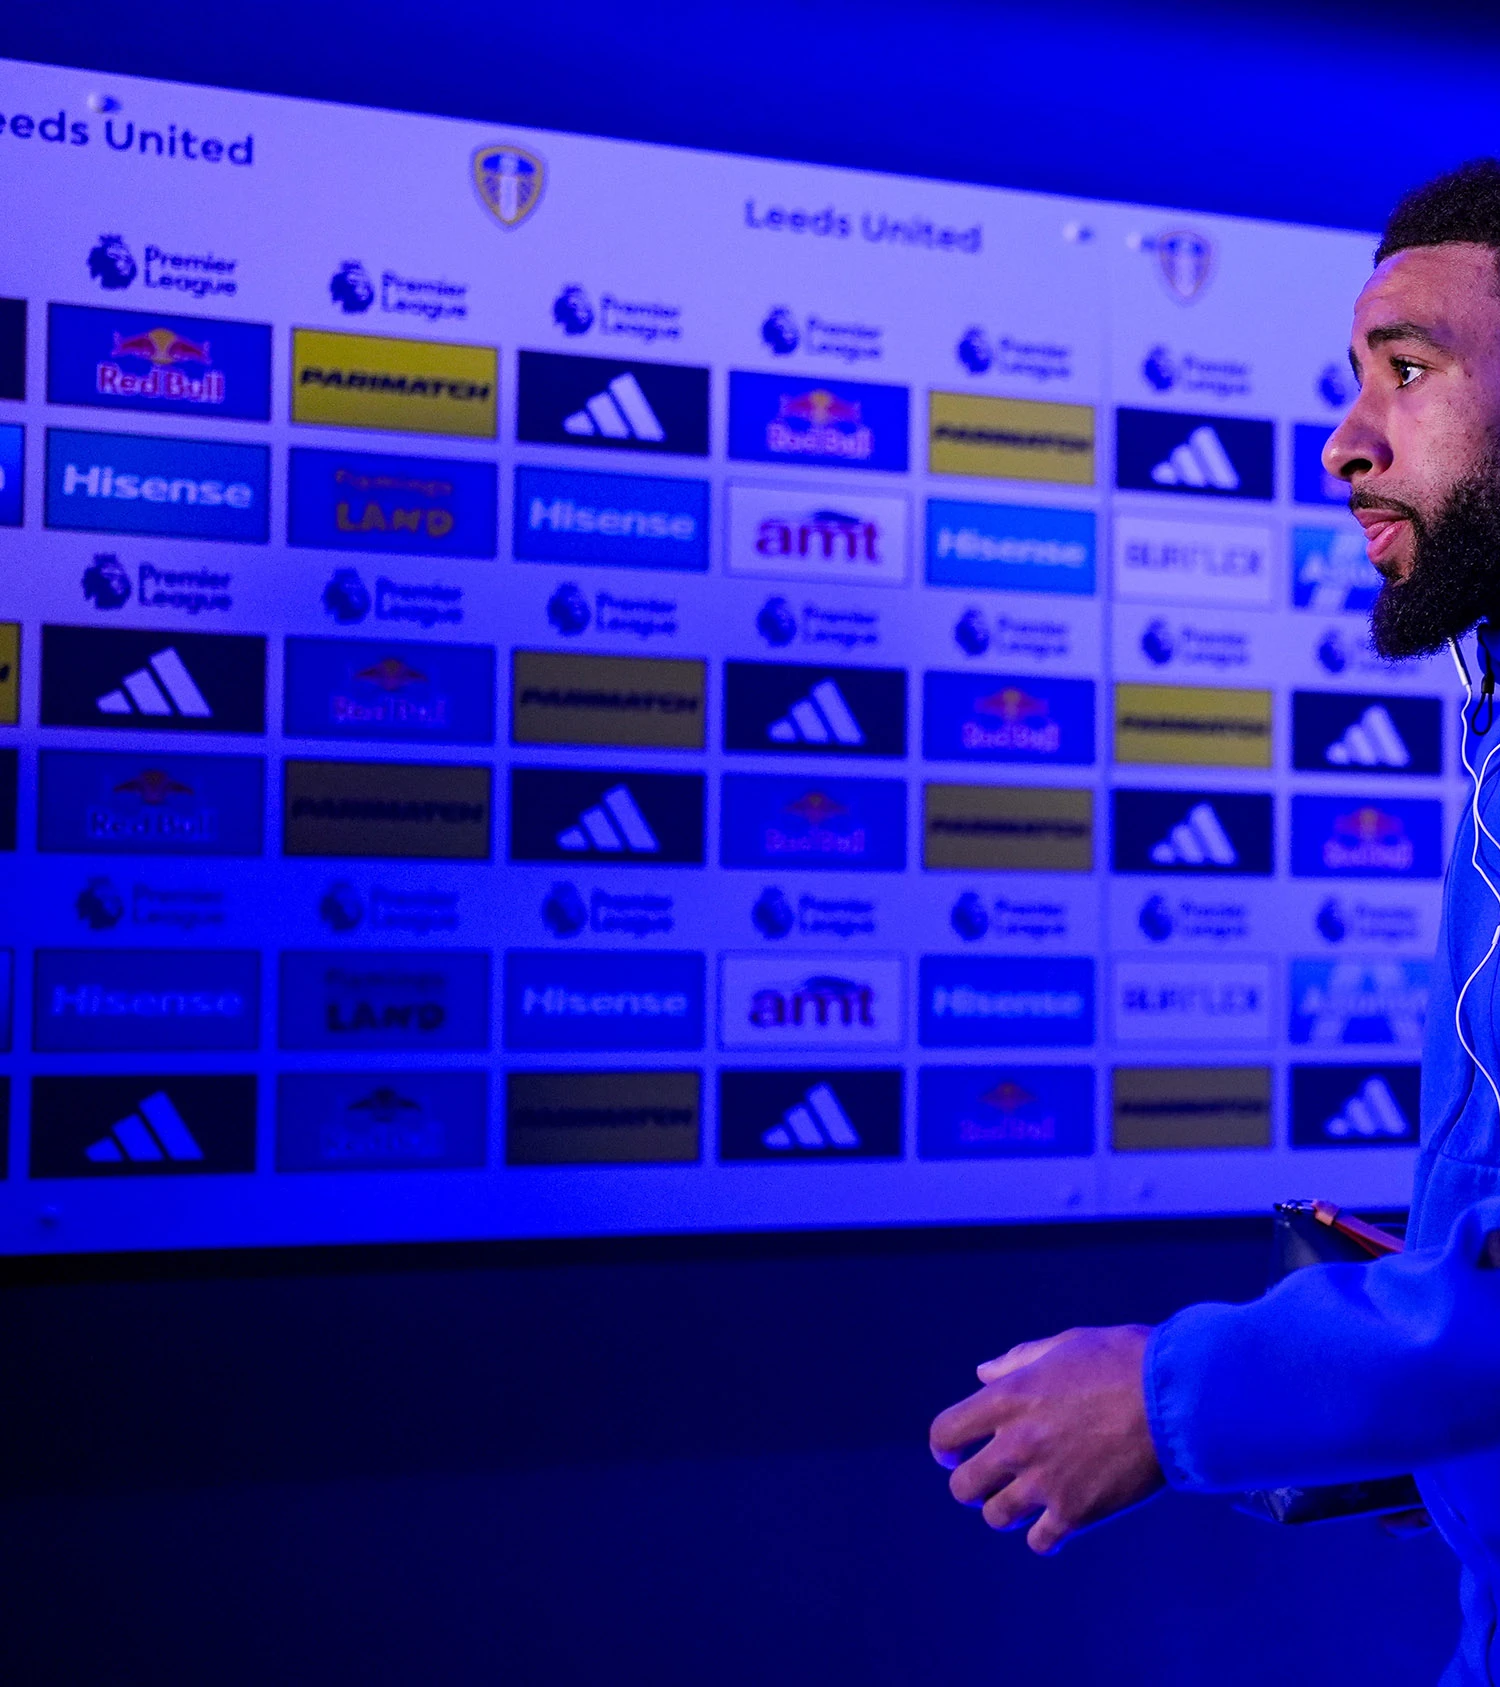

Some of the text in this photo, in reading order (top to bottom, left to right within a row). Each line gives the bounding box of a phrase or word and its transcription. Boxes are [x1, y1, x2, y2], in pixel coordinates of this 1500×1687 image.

[0, 110, 255, 167] eds United
[745, 197, 984, 255] Leeds United
[144, 243, 238, 275] Premier
[144, 267, 238, 299] League
[381, 269, 468, 298] Premier
[381, 293, 468, 321] League
[97, 361, 225, 403] Red Bull
[300, 366, 492, 402] PARIMATCH
[62, 463, 254, 509] Hisense
[336, 501, 455, 538] LAND
[529, 498, 697, 541] Hisense
[755, 515, 880, 563] amt
[937, 527, 1088, 568] Hisense
[51, 983, 244, 1018] Hisense
[326, 1002, 448, 1034] LAND
[520, 985, 688, 1018] Hisense
[748, 984, 876, 1029] amt
